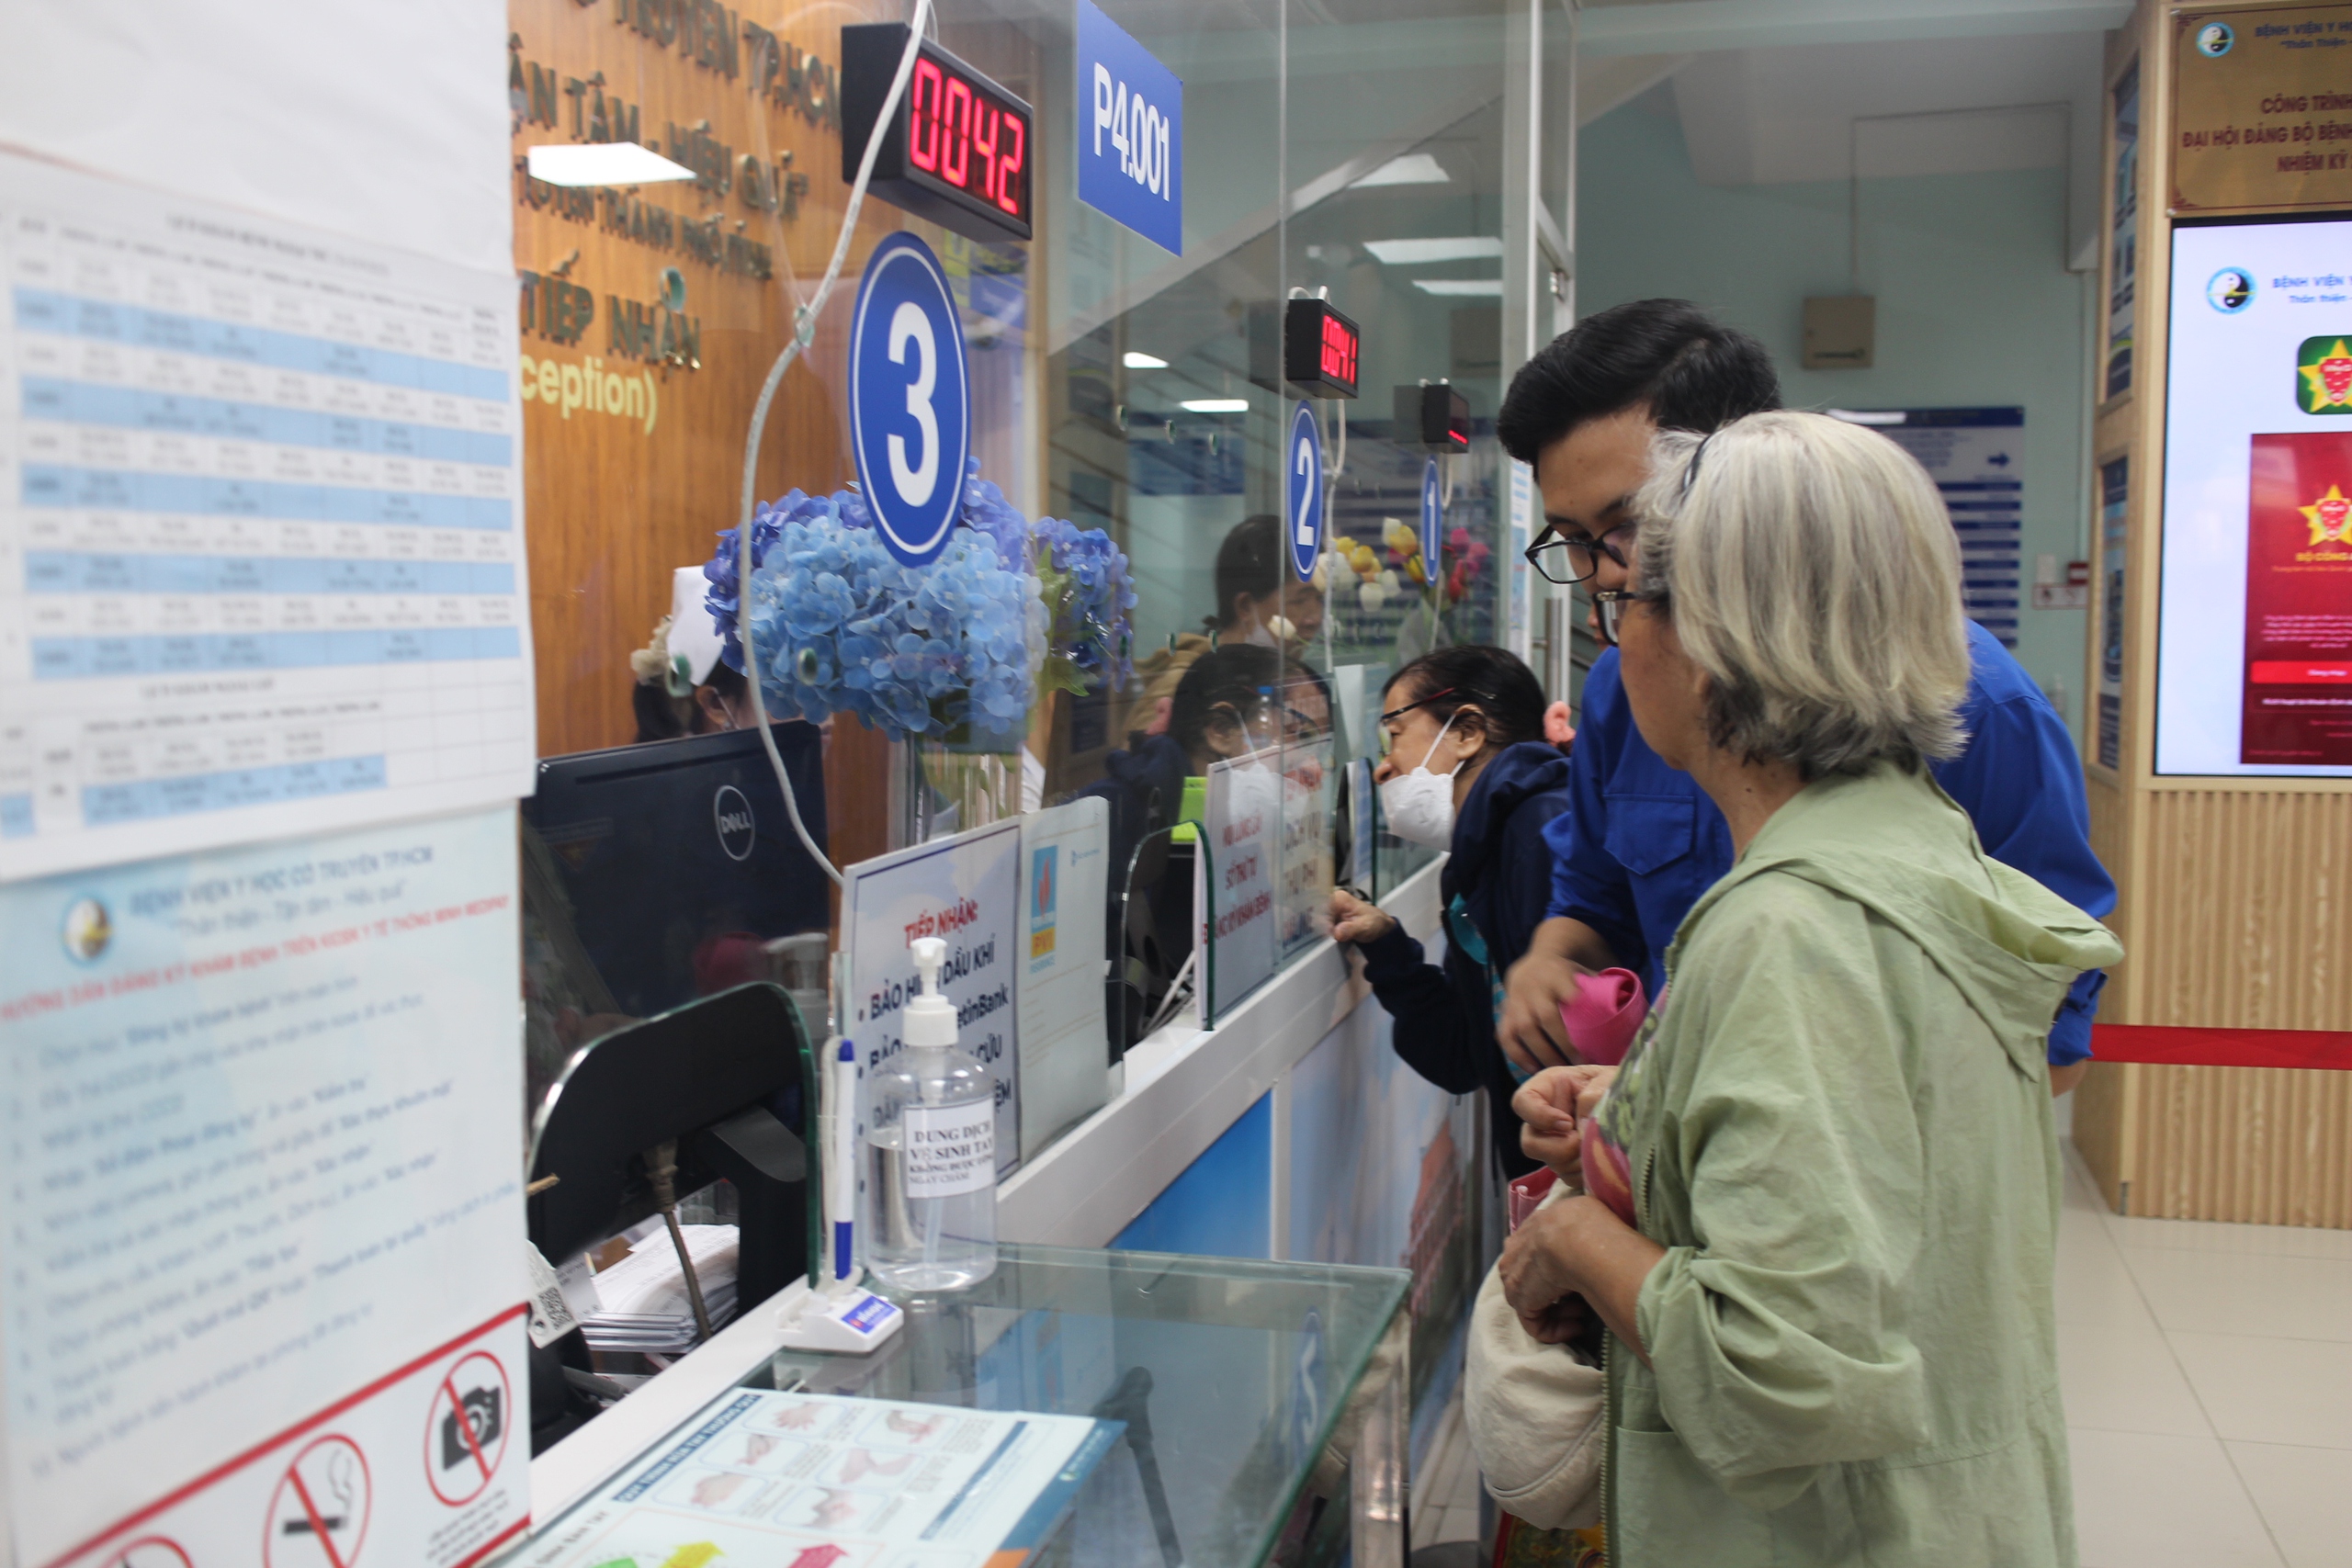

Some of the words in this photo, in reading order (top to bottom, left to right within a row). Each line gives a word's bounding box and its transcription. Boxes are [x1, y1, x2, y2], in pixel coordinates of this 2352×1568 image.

[1093, 62, 1170, 202] P4.001
[2261, 93, 2309, 114] CÔNG
[910, 58, 1024, 215] 0042
[2182, 130, 2209, 152] ĐẠI
[2212, 125, 2240, 150] HỘI
[2244, 122, 2289, 144] ĐẢNG
[2291, 120, 2314, 147] BỘ
[2277, 151, 2324, 175] NHIỆM
[520, 248, 595, 348] TIẾP
[520, 354, 658, 436] ception)
[888, 301, 940, 507] 3
[1296, 437, 1316, 547] 2
[1428, 480, 1436, 561] 1
[719, 812, 751, 834] DELL
[871, 978, 902, 1020] BẢO
[914, 1127, 959, 1143] DUNG
[935, 1144, 971, 1159] SINH
